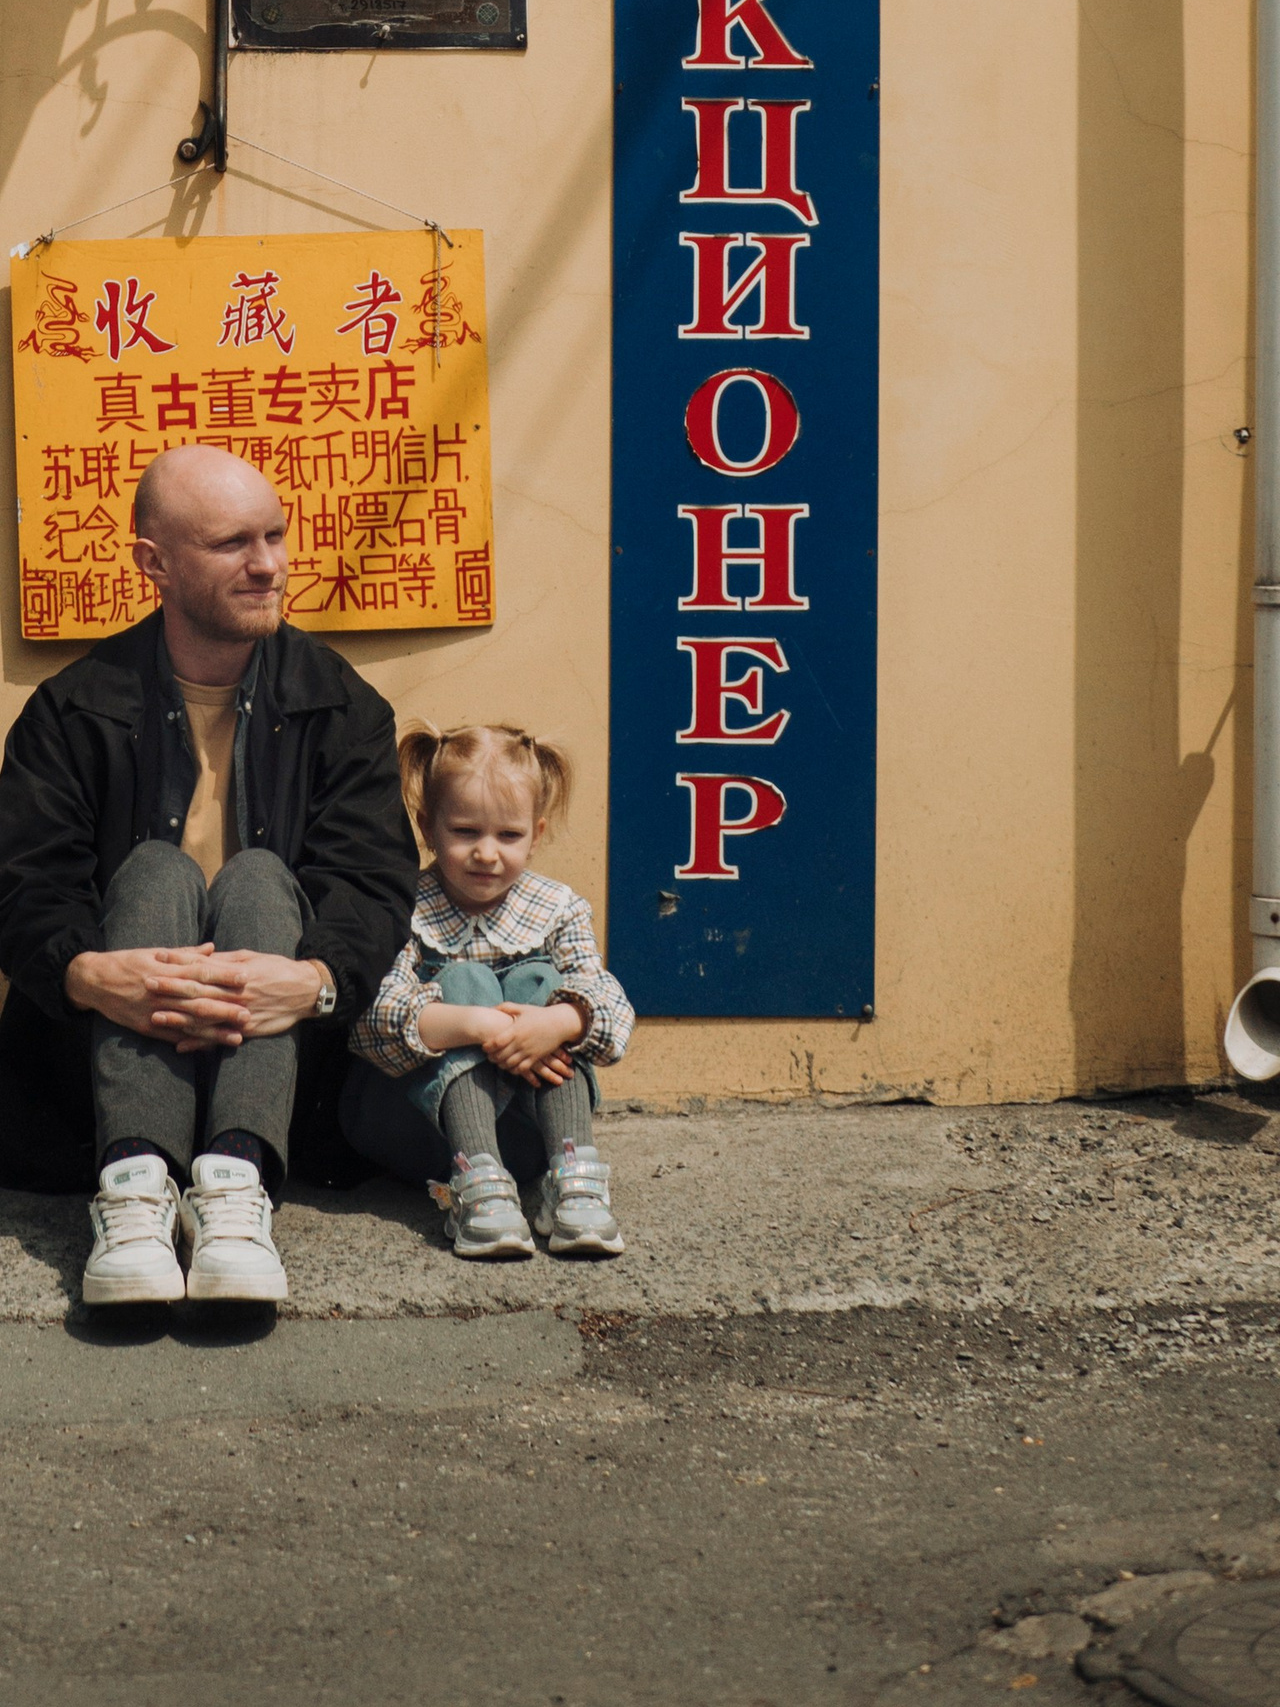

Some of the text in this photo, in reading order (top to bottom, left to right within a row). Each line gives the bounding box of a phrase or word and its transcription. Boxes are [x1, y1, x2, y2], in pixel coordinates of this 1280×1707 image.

[94, 269, 404, 362] 收藏者
[94, 359, 416, 433] 真古董专卖店
